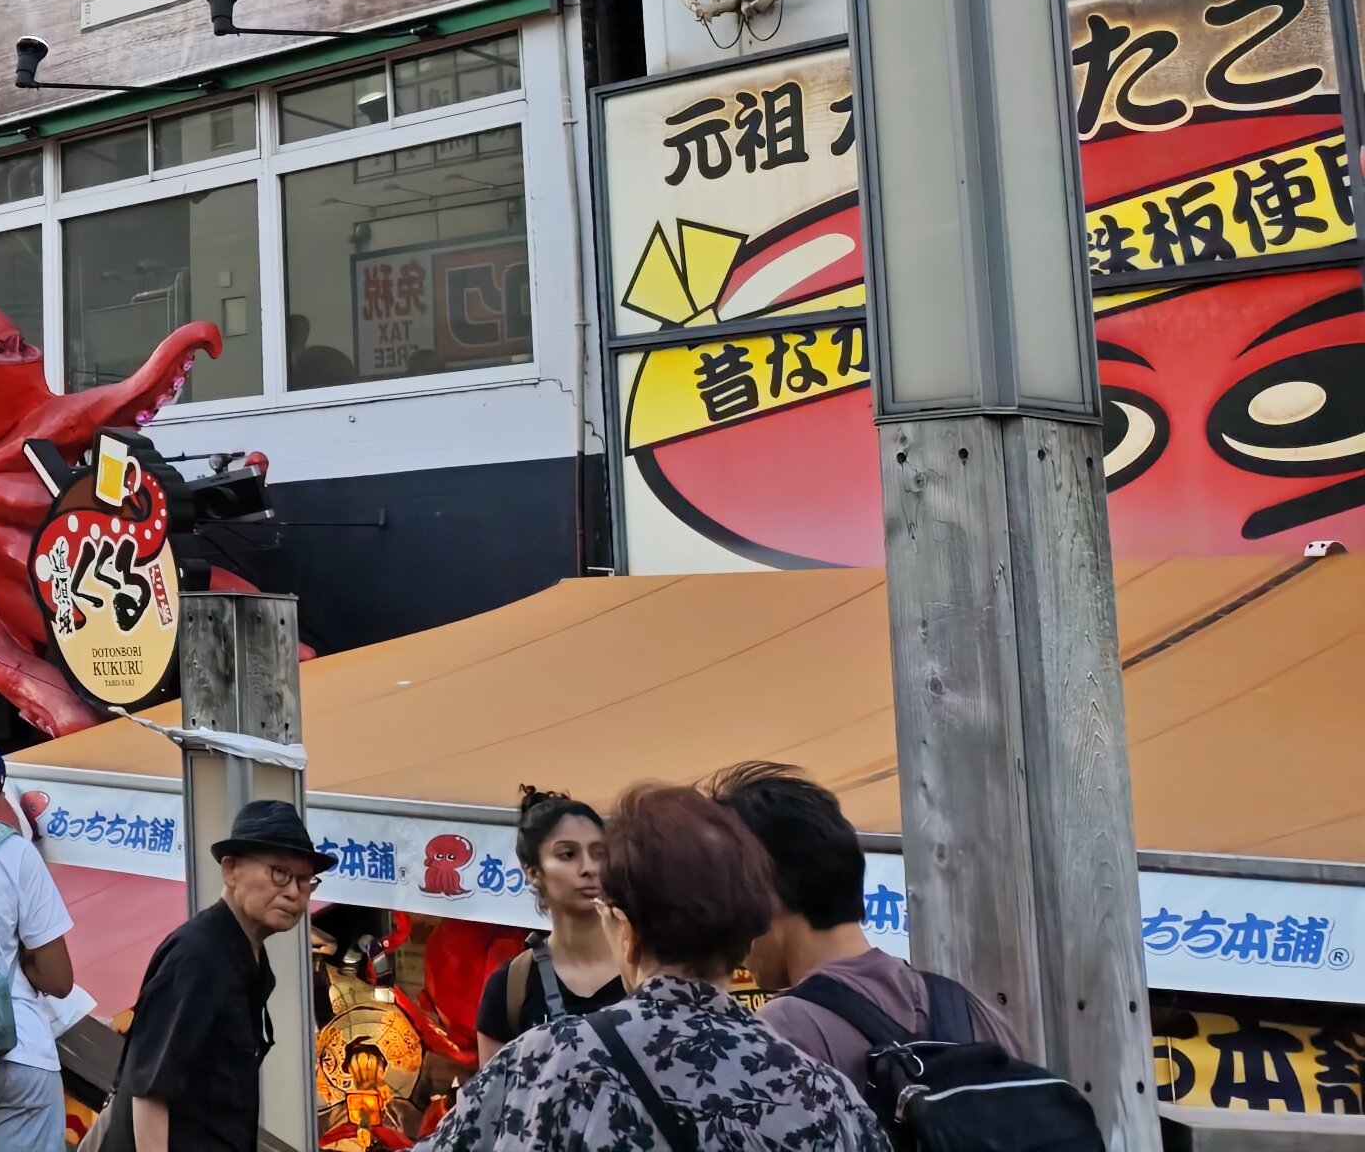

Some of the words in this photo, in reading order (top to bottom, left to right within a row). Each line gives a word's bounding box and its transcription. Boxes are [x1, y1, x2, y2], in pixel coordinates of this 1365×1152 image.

[665, 82, 810, 187] 元祖
[70, 537, 152, 633] くくる
[92, 646, 143, 659] DOTONBORI
[93, 660, 144, 677] KUKURU
[47, 806, 176, 855] あっちち本舗
